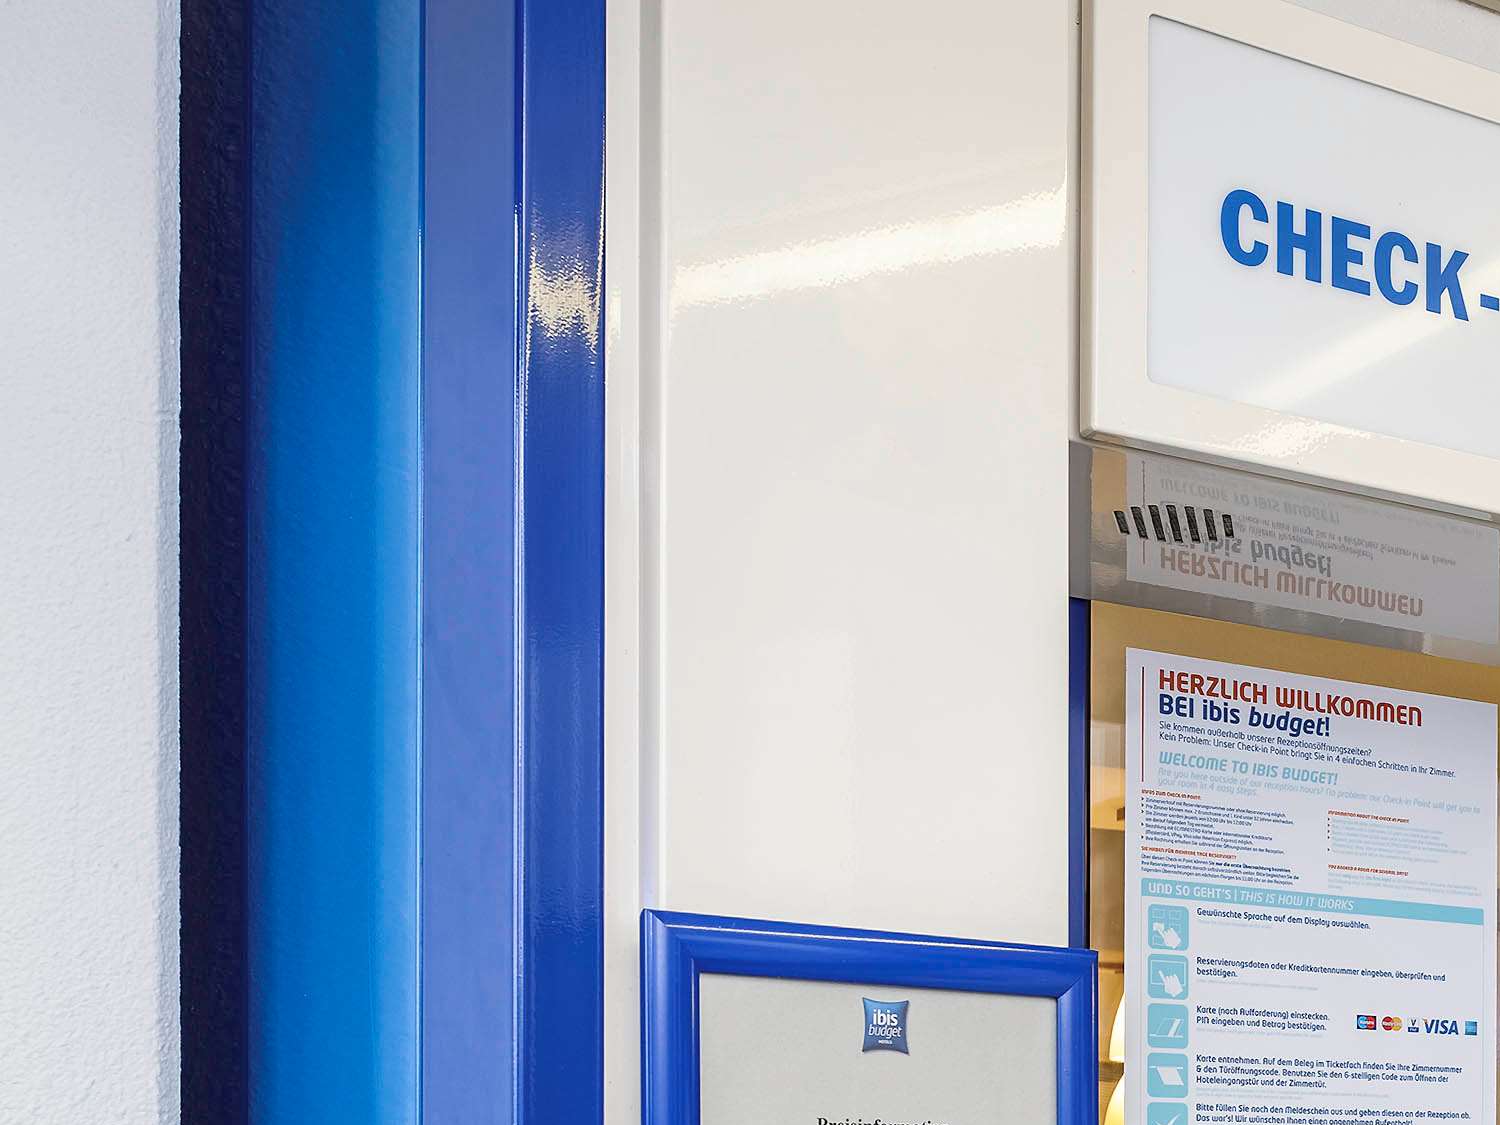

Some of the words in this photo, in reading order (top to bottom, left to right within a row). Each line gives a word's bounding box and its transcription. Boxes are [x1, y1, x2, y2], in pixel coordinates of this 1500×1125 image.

[1159, 668, 1267, 704] HERZLICH
[1275, 686, 1422, 727] WILLKOMMEN
[1159, 693, 1194, 718] BEI
[1202, 698, 1240, 724] ibis
[1248, 705, 1330, 737] budget!
[1158, 750, 1228, 772] WELCOME
[1231, 760, 1248, 774] TO
[1251, 762, 1279, 778] IBIS
[1281, 766, 1338, 786] BUDGET!
[1149, 882, 1172, 896] UND
[1175, 884, 1190, 897] SO
[1193, 886, 1232, 901] GEHT'S
[1239, 890, 1264, 904] THIS
[1264, 890, 1276, 904] IS
[1277, 893, 1303, 906] HOW
[1305, 896, 1316, 907] IT
[1317, 895, 1354, 912] WORKS
[868, 1023, 903, 1039] budget
[873, 1009, 898, 1026] ibis
[1423, 1019, 1459, 1035] VISA
